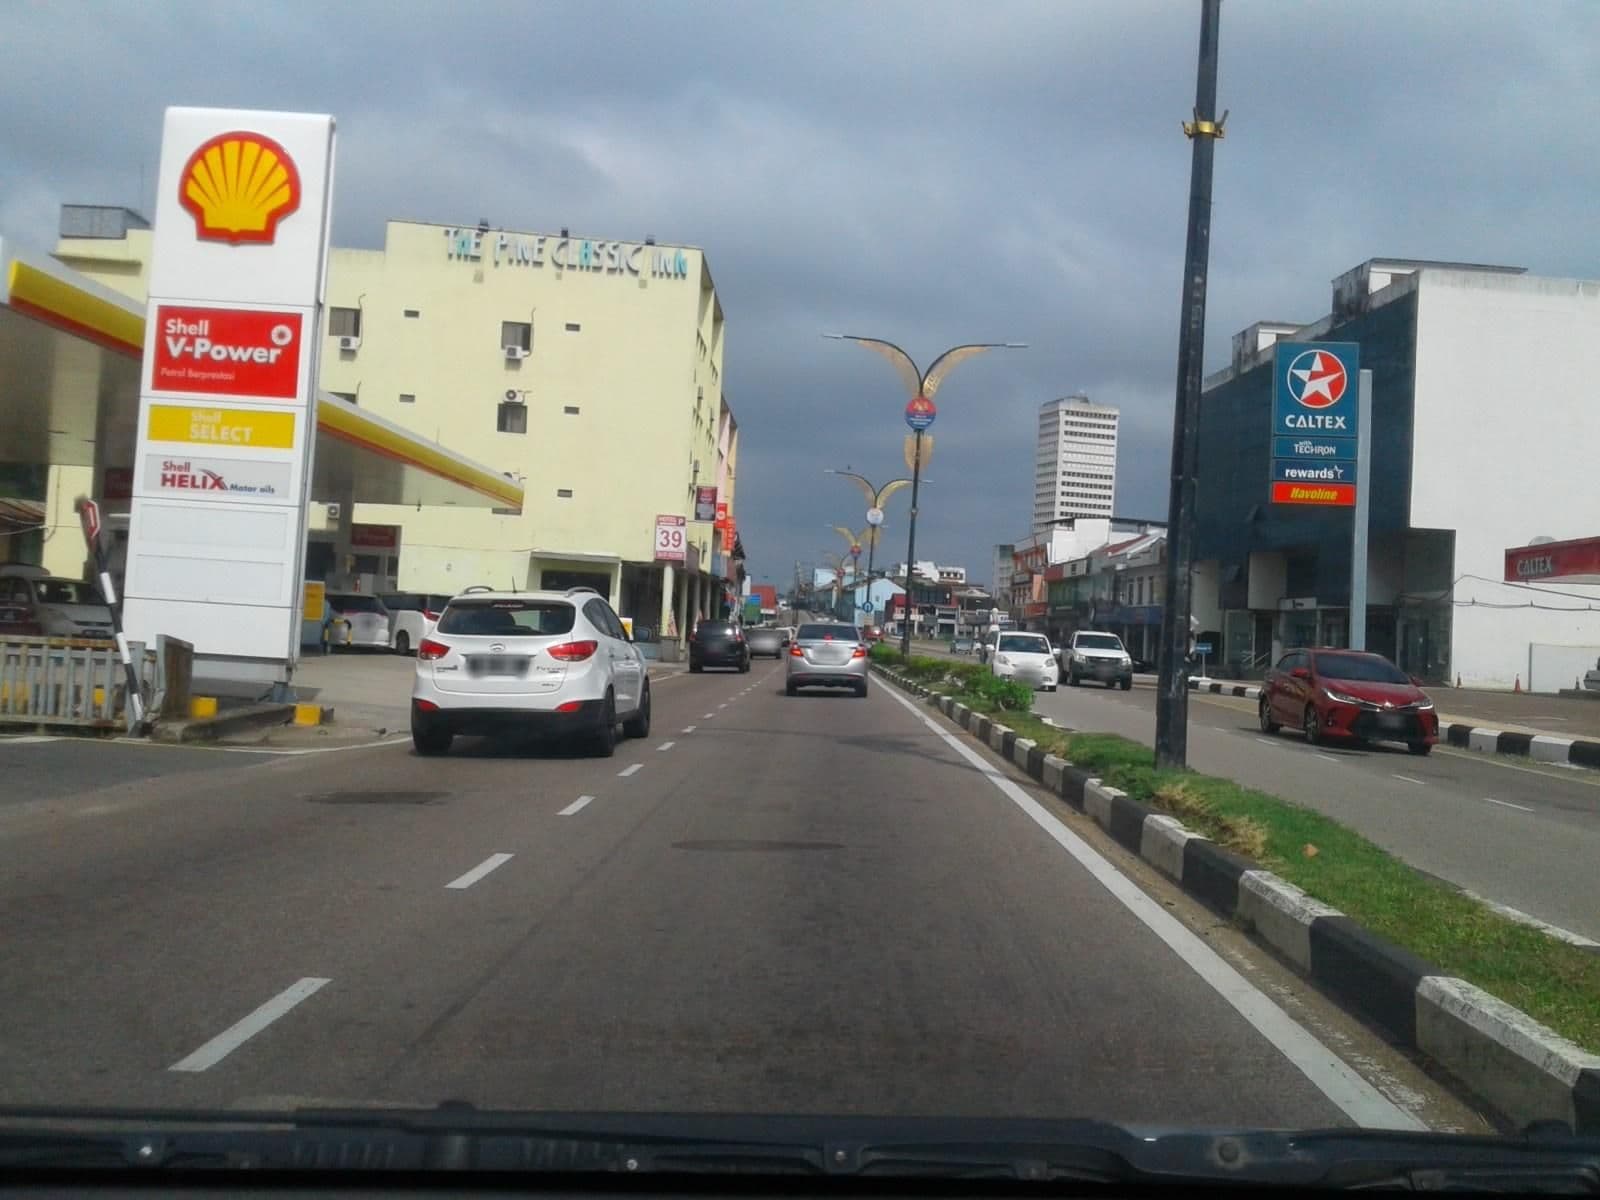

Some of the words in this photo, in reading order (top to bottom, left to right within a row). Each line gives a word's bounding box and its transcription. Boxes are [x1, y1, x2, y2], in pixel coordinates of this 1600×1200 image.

[445, 227, 483, 262] THE
[494, 235, 546, 267] PINE
[551, 240, 643, 275] CLASSIC
[651, 248, 688, 280] INN
[166, 318, 210, 336] Shell
[166, 336, 282, 364] V-Power
[192, 410, 222, 424] Shell
[1285, 414, 1346, 429] CALTEX
[191, 423, 253, 443] SELECT
[1294, 444, 1336, 456] TECHRON
[162, 461, 191, 473] Shell
[1285, 467, 1334, 479] rewards
[160, 468, 229, 491] HELIX
[259, 485, 275, 494] oils
[1290, 487, 1338, 500] Havoline
[660, 530, 682, 548] 39
[1516, 555, 1553, 577] CALTEX
